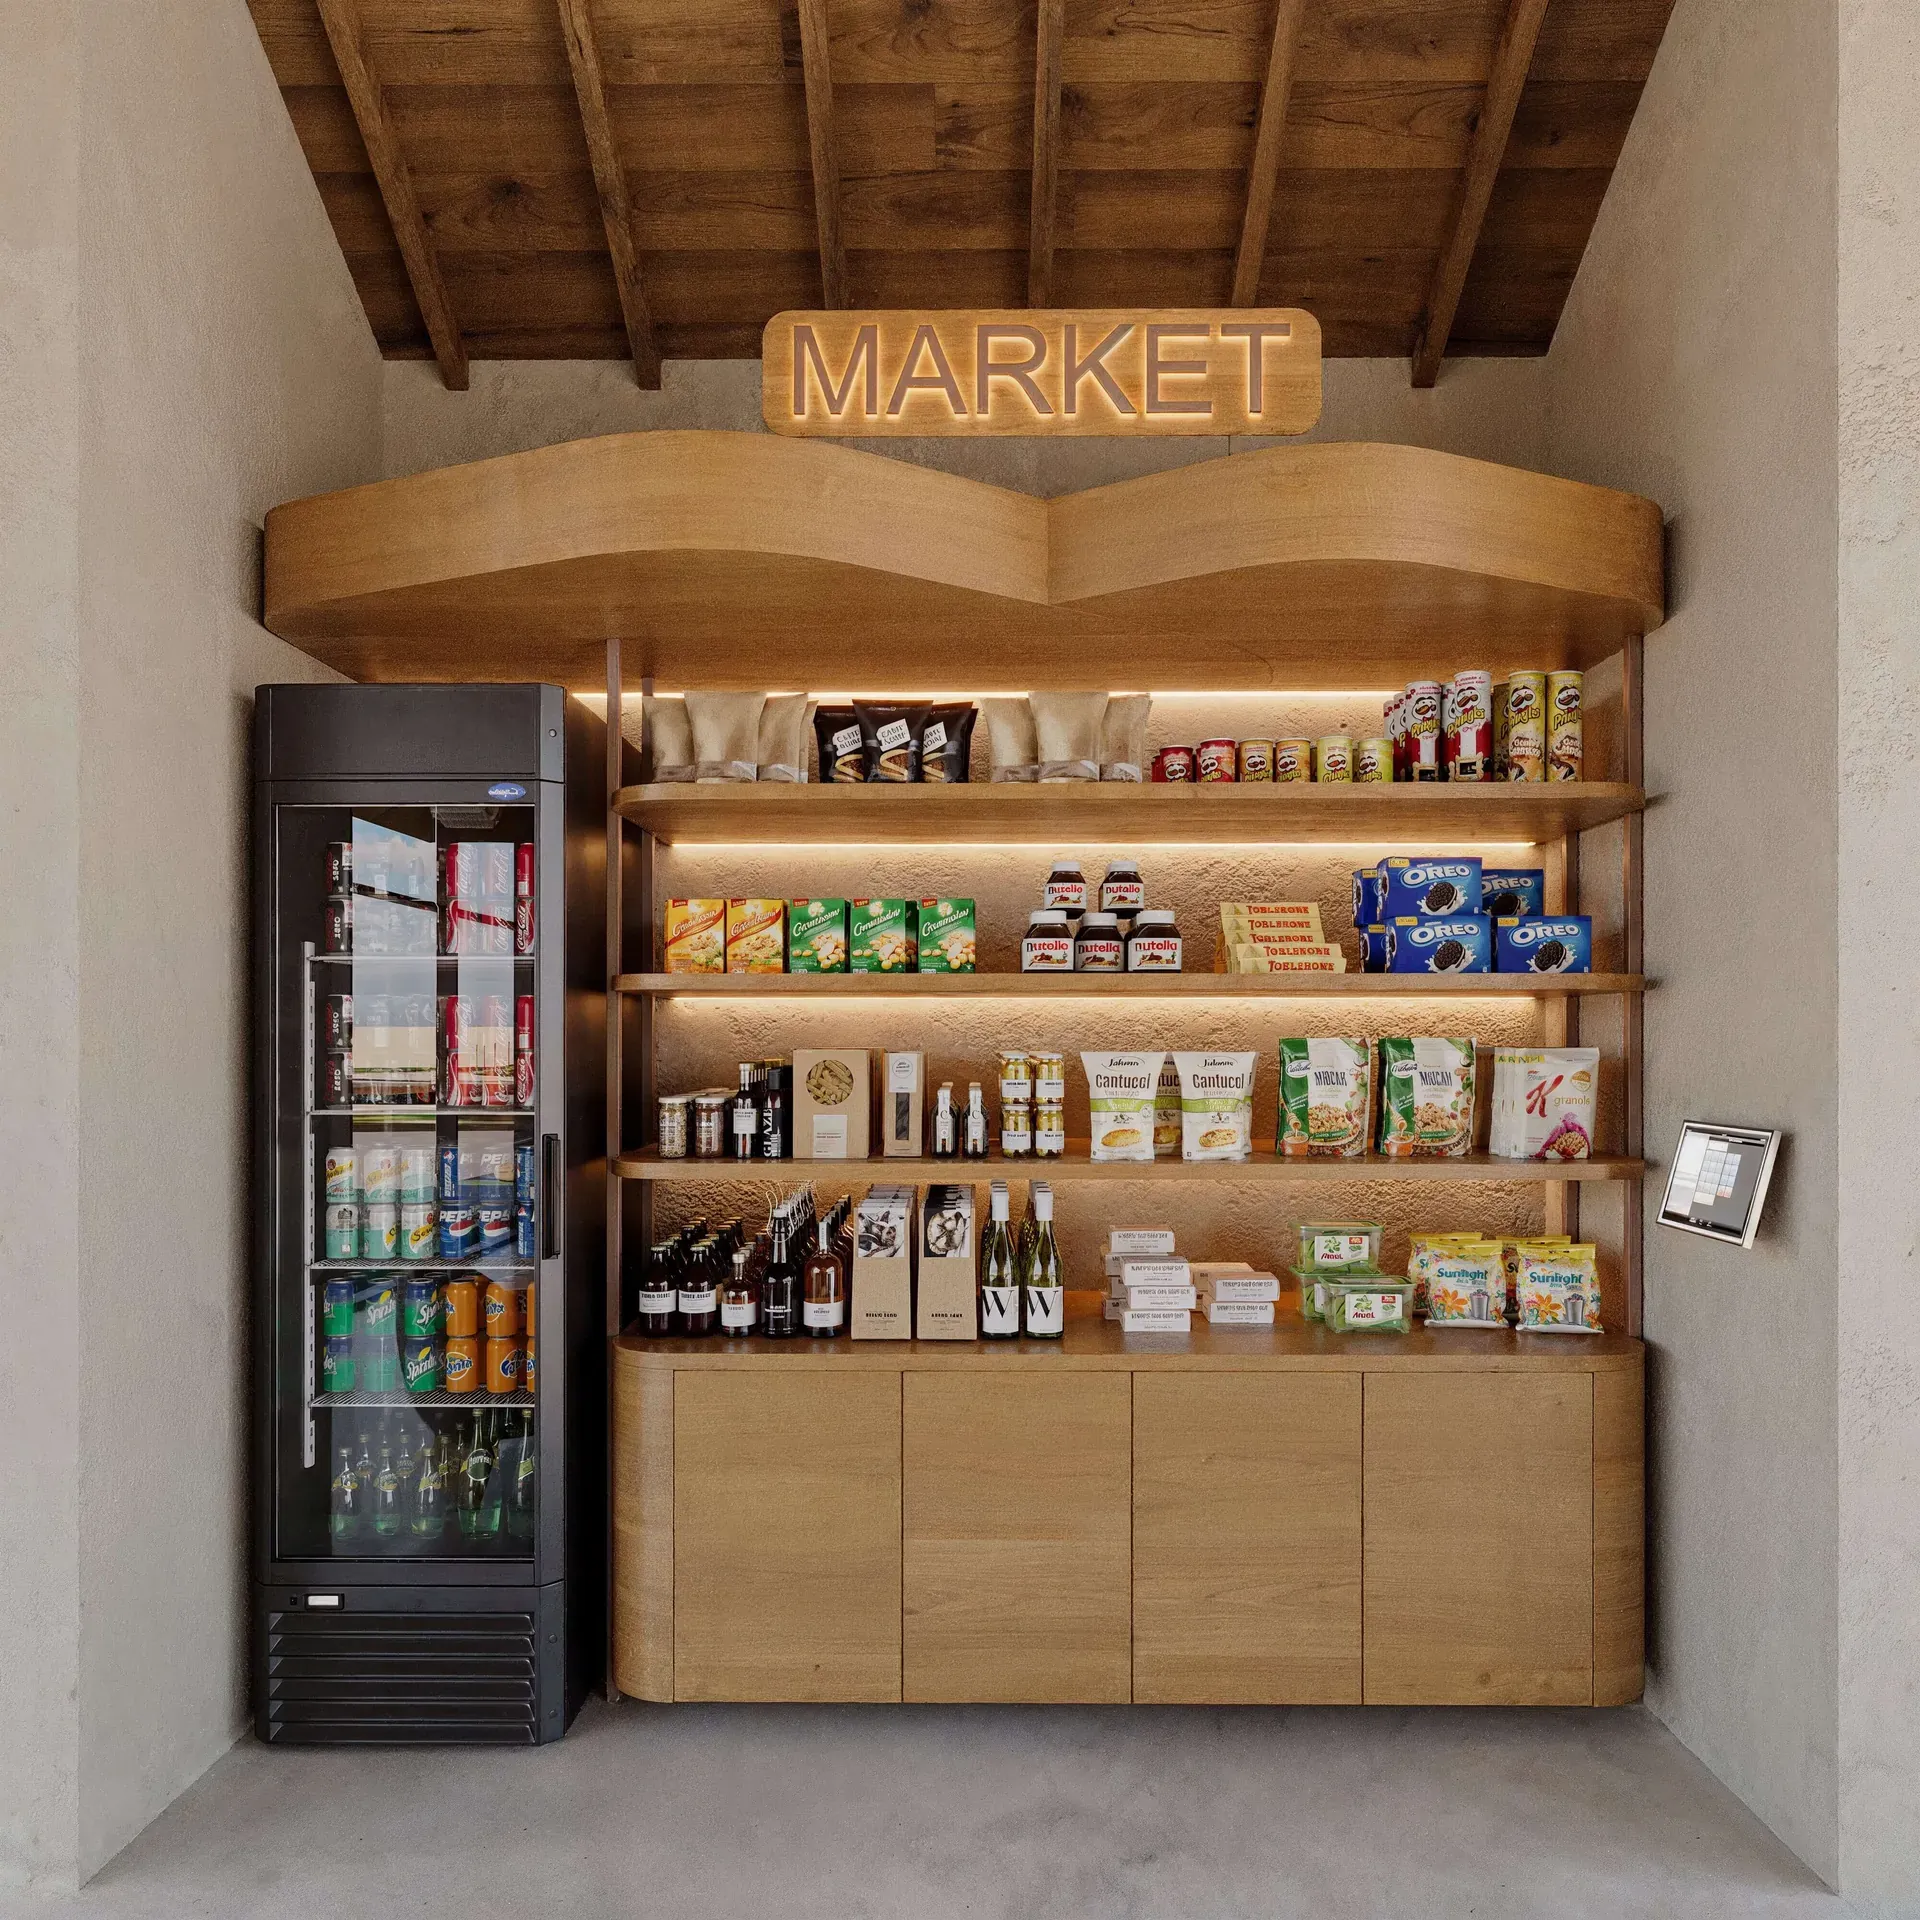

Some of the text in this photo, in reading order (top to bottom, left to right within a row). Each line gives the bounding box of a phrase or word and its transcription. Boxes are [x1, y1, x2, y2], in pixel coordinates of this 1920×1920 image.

[793, 324, 1290, 415] MARKET
[1403, 866, 1470, 885] OREO
[1411, 924, 1479, 944] OREO
[1512, 925, 1580, 944] OREO
[982, 1289, 1015, 1318] W
[1027, 1289, 1060, 1318] W
